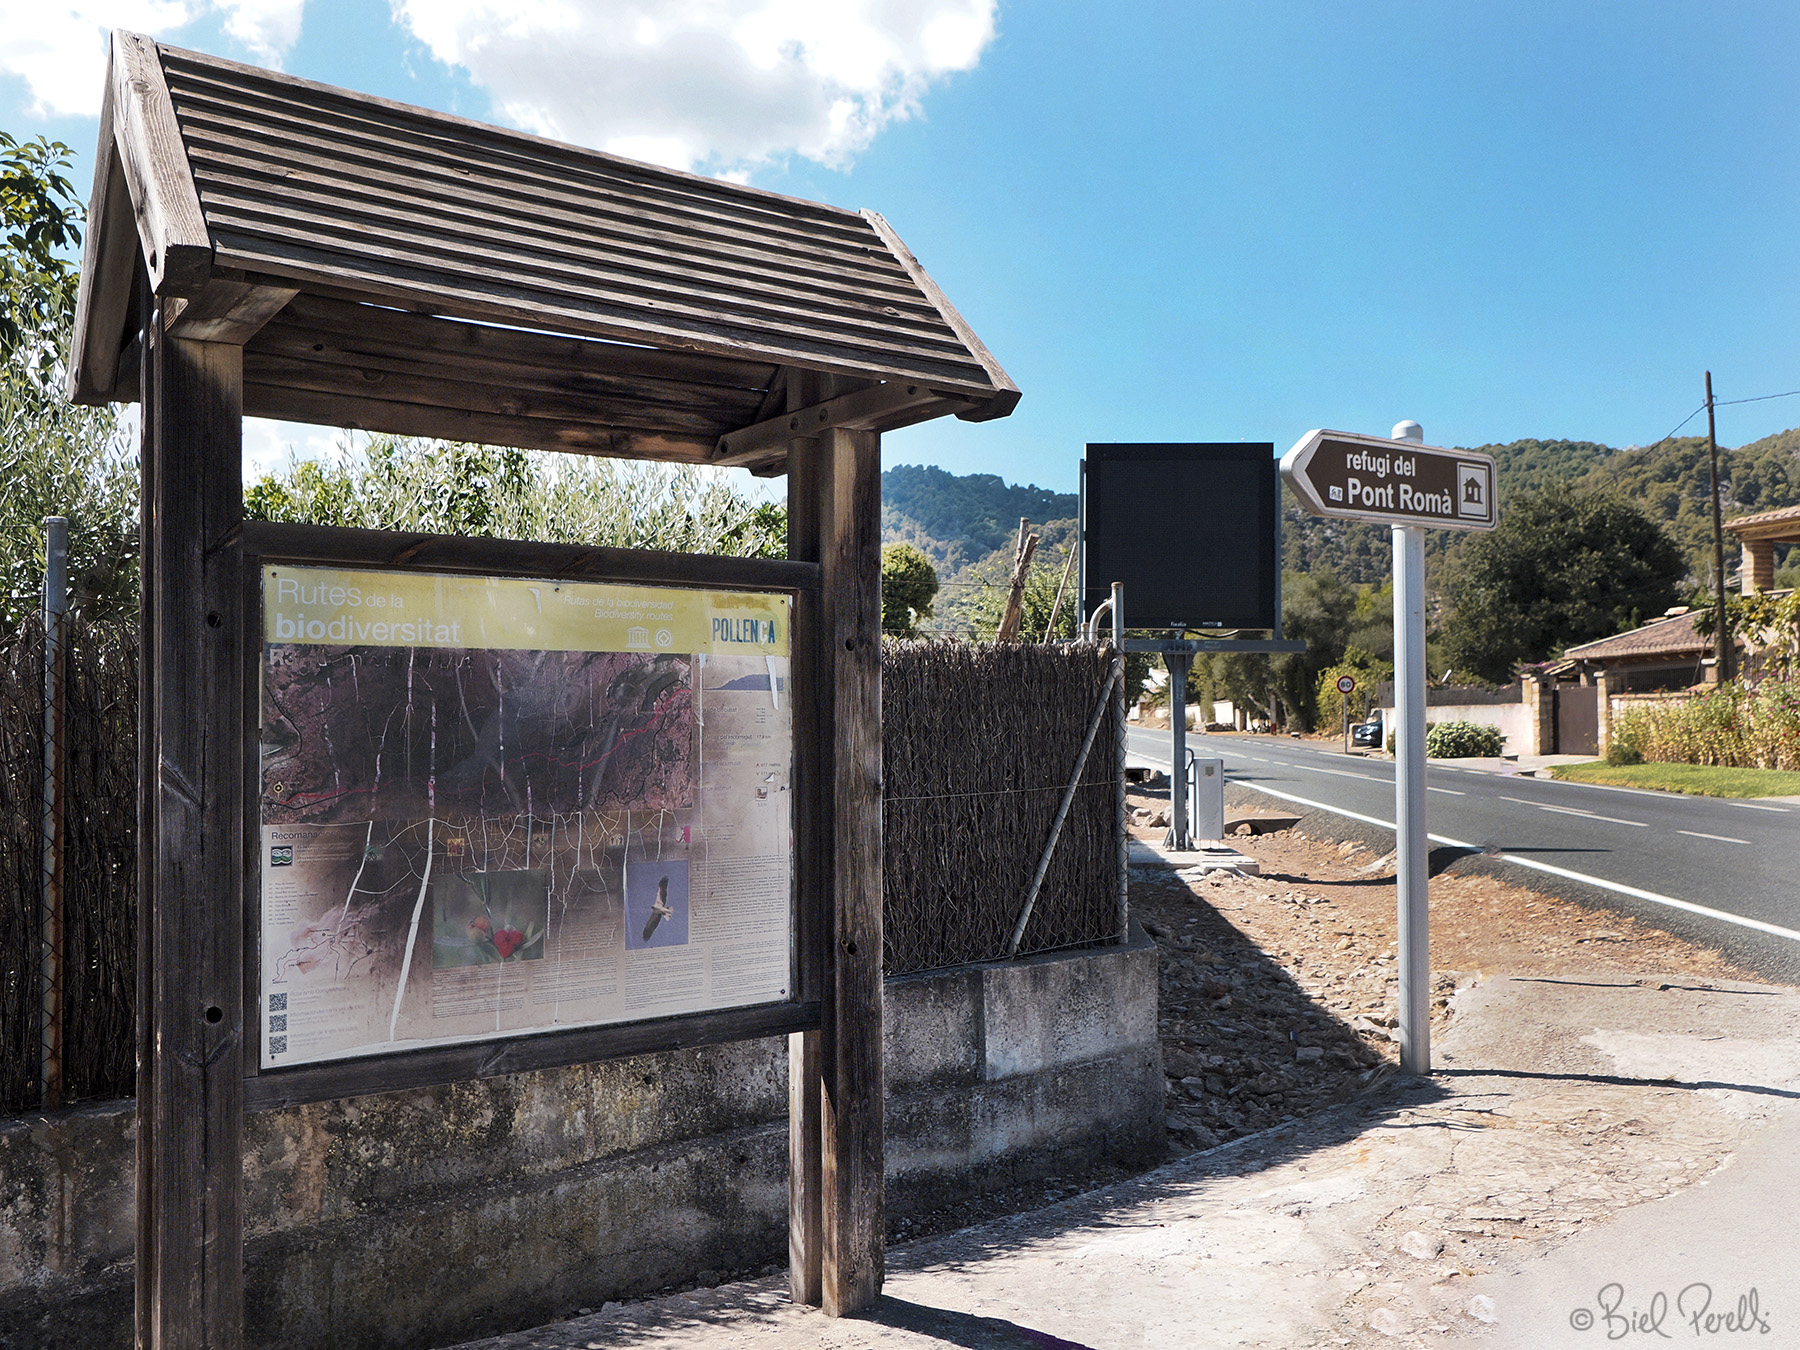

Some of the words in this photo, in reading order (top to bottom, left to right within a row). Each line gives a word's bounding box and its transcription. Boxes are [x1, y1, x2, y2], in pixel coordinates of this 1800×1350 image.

[1346, 450, 1390, 478] refugi
[1394, 455, 1416, 477] del
[1347, 477, 1394, 509] Pont
[1399, 483, 1452, 515] Romà
[277, 578, 363, 607] Rutes
[365, 593, 386, 608] de
[390, 593, 404, 609] la
[563, 595, 590, 606] Rutas
[592, 597, 604, 606] de
[606, 597, 614, 607] la
[616, 598, 674, 610] biodiversidad
[275, 612, 461, 643] biodiversitat
[594, 608, 645, 621] Biodiversity
[646, 610, 673, 621] routes
[712, 617, 776, 645] POLLENÇA
